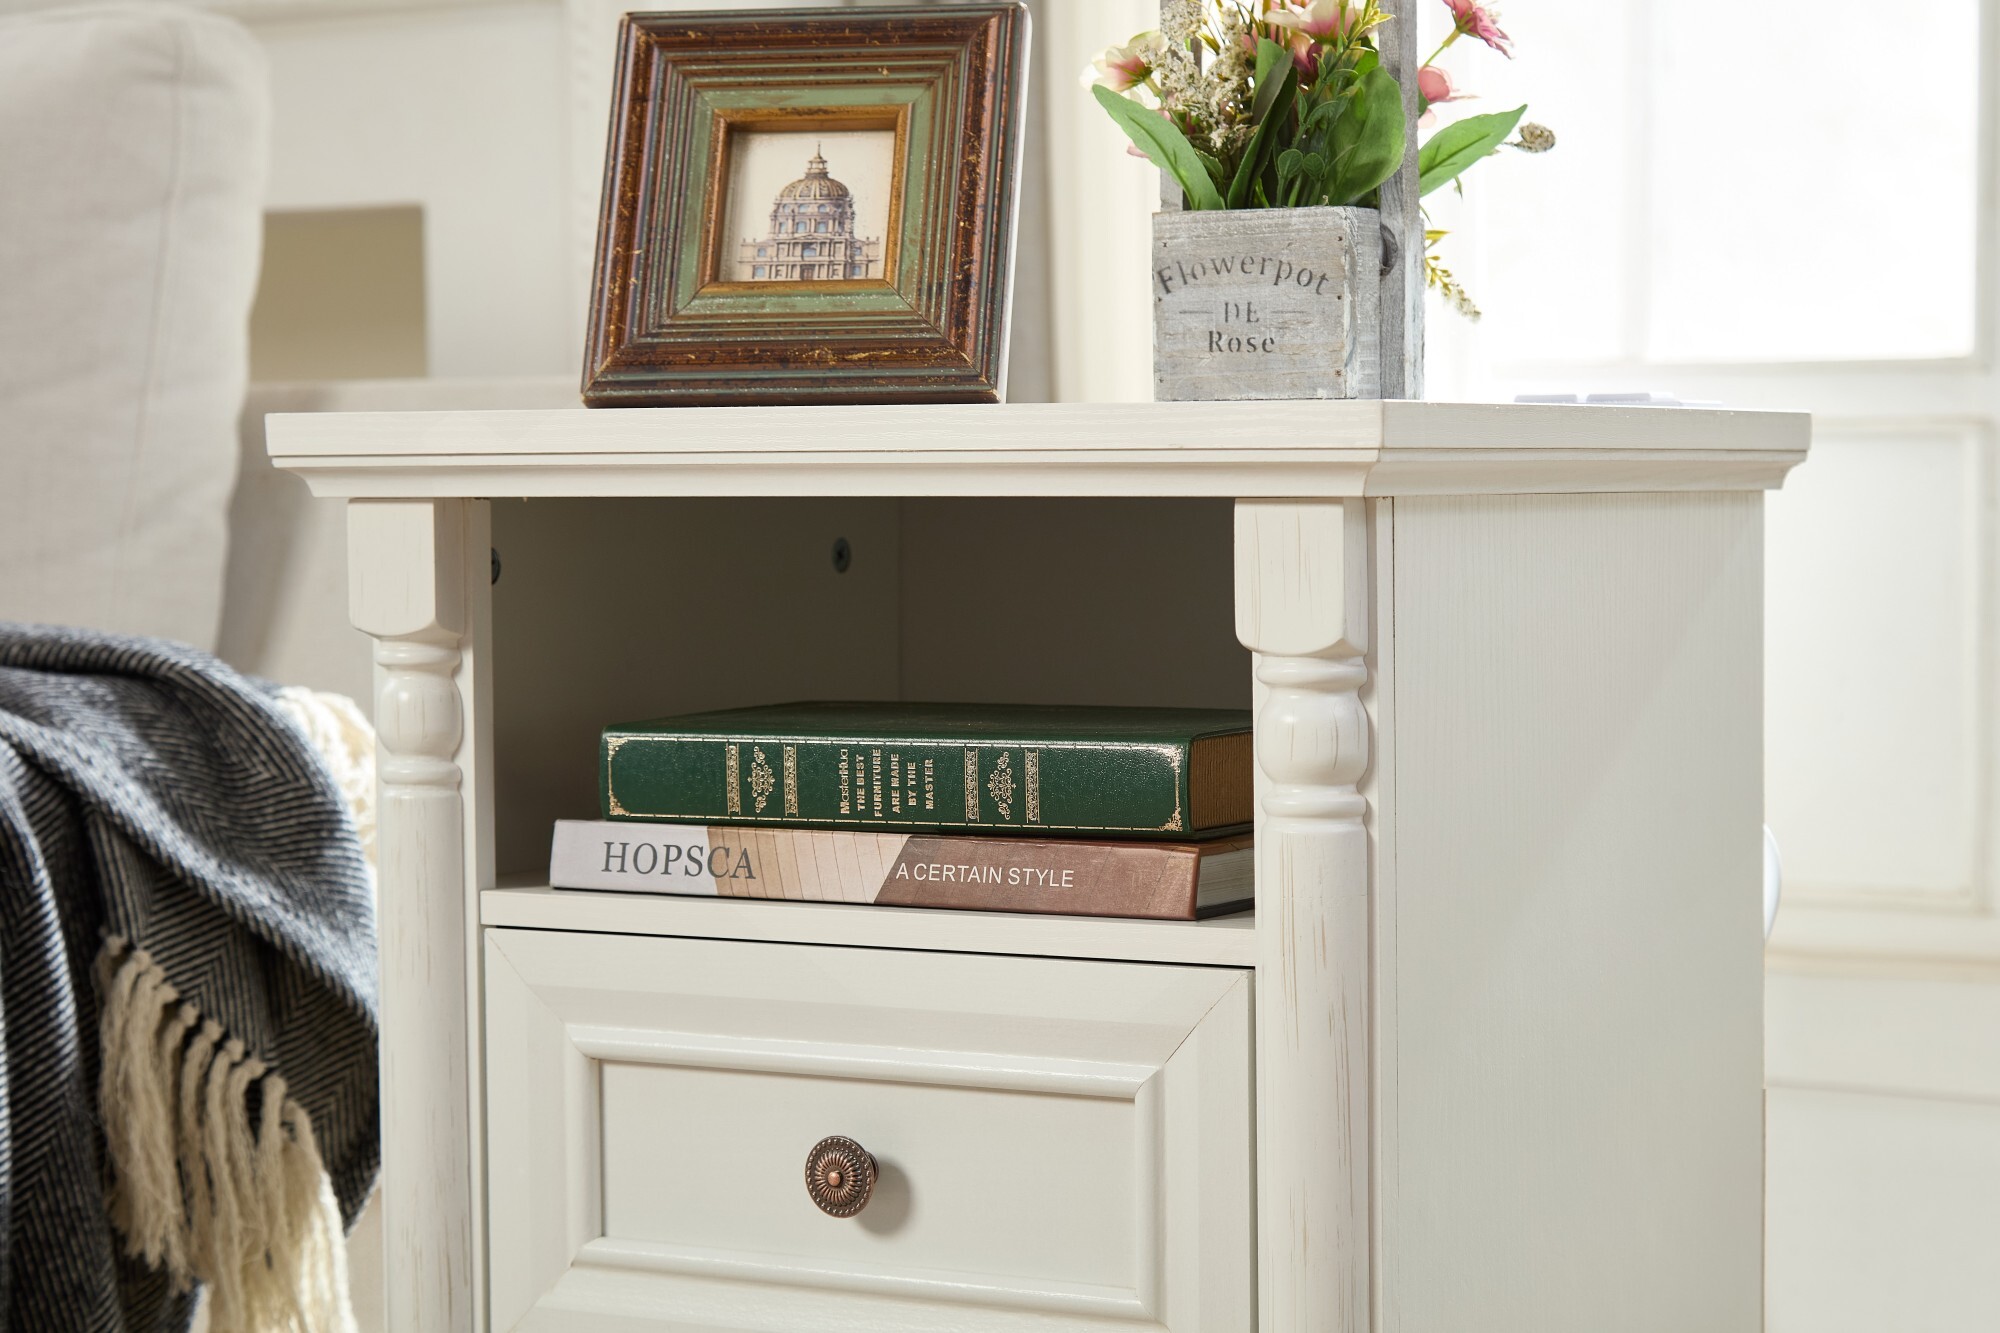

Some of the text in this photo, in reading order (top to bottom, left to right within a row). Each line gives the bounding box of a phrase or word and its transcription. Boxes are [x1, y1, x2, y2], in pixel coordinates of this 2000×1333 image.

[1156, 255, 1330, 296] Flowerpot
[1224, 301, 1260, 324] DE
[1208, 330, 1275, 354] Rose
[856, 754, 866, 812] THE BEST
[872, 748, 882, 817] FURNITURE
[890, 753, 901, 814] ARE MADE
[907, 762, 917, 806] BY THE
[924, 758, 934, 810] MASTER
[601, 841, 757, 880] HOPSCA
[896, 862, 1074, 888] A CERTAIN STYLE
